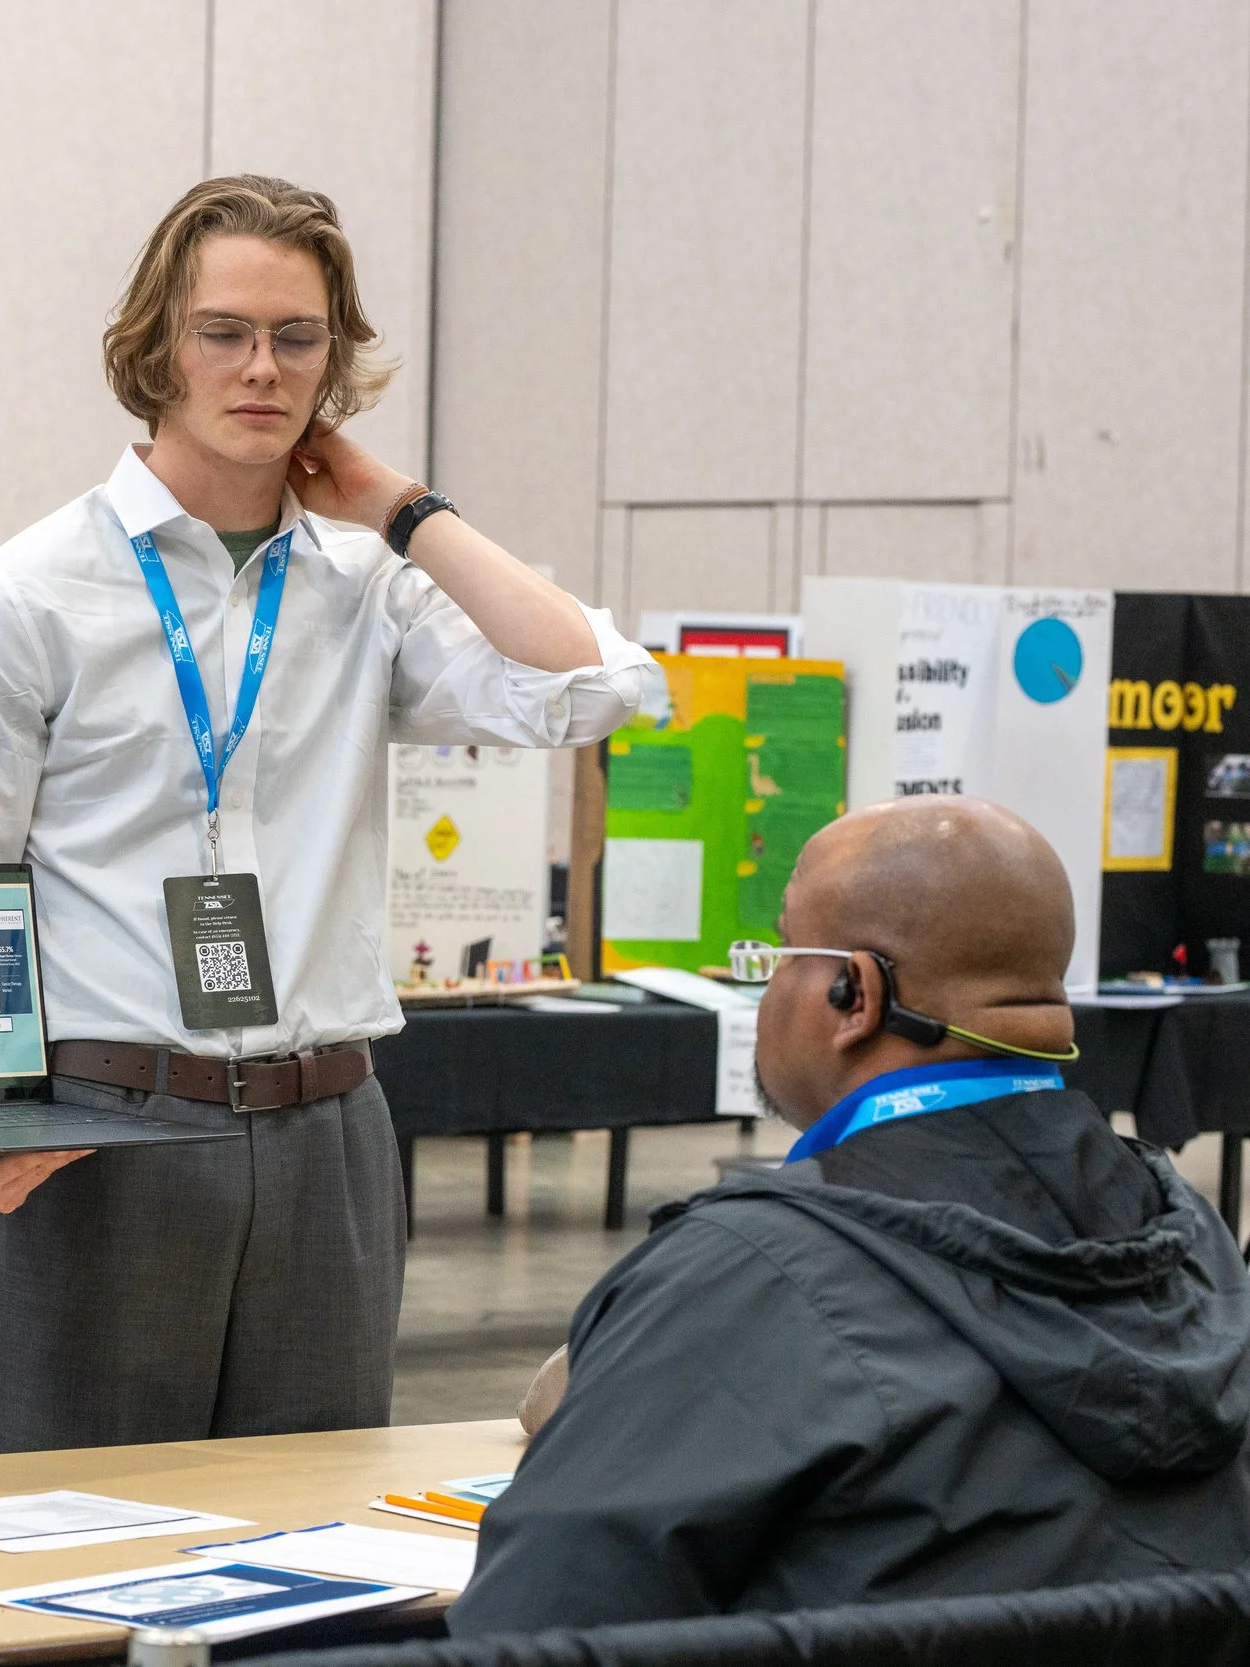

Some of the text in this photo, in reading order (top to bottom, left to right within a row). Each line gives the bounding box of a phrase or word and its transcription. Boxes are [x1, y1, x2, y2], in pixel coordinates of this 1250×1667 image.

[256, 625, 273, 674] TENNESSEE
[204, 901, 224, 909] TSA
[228, 995, 260, 1003] 22625102
